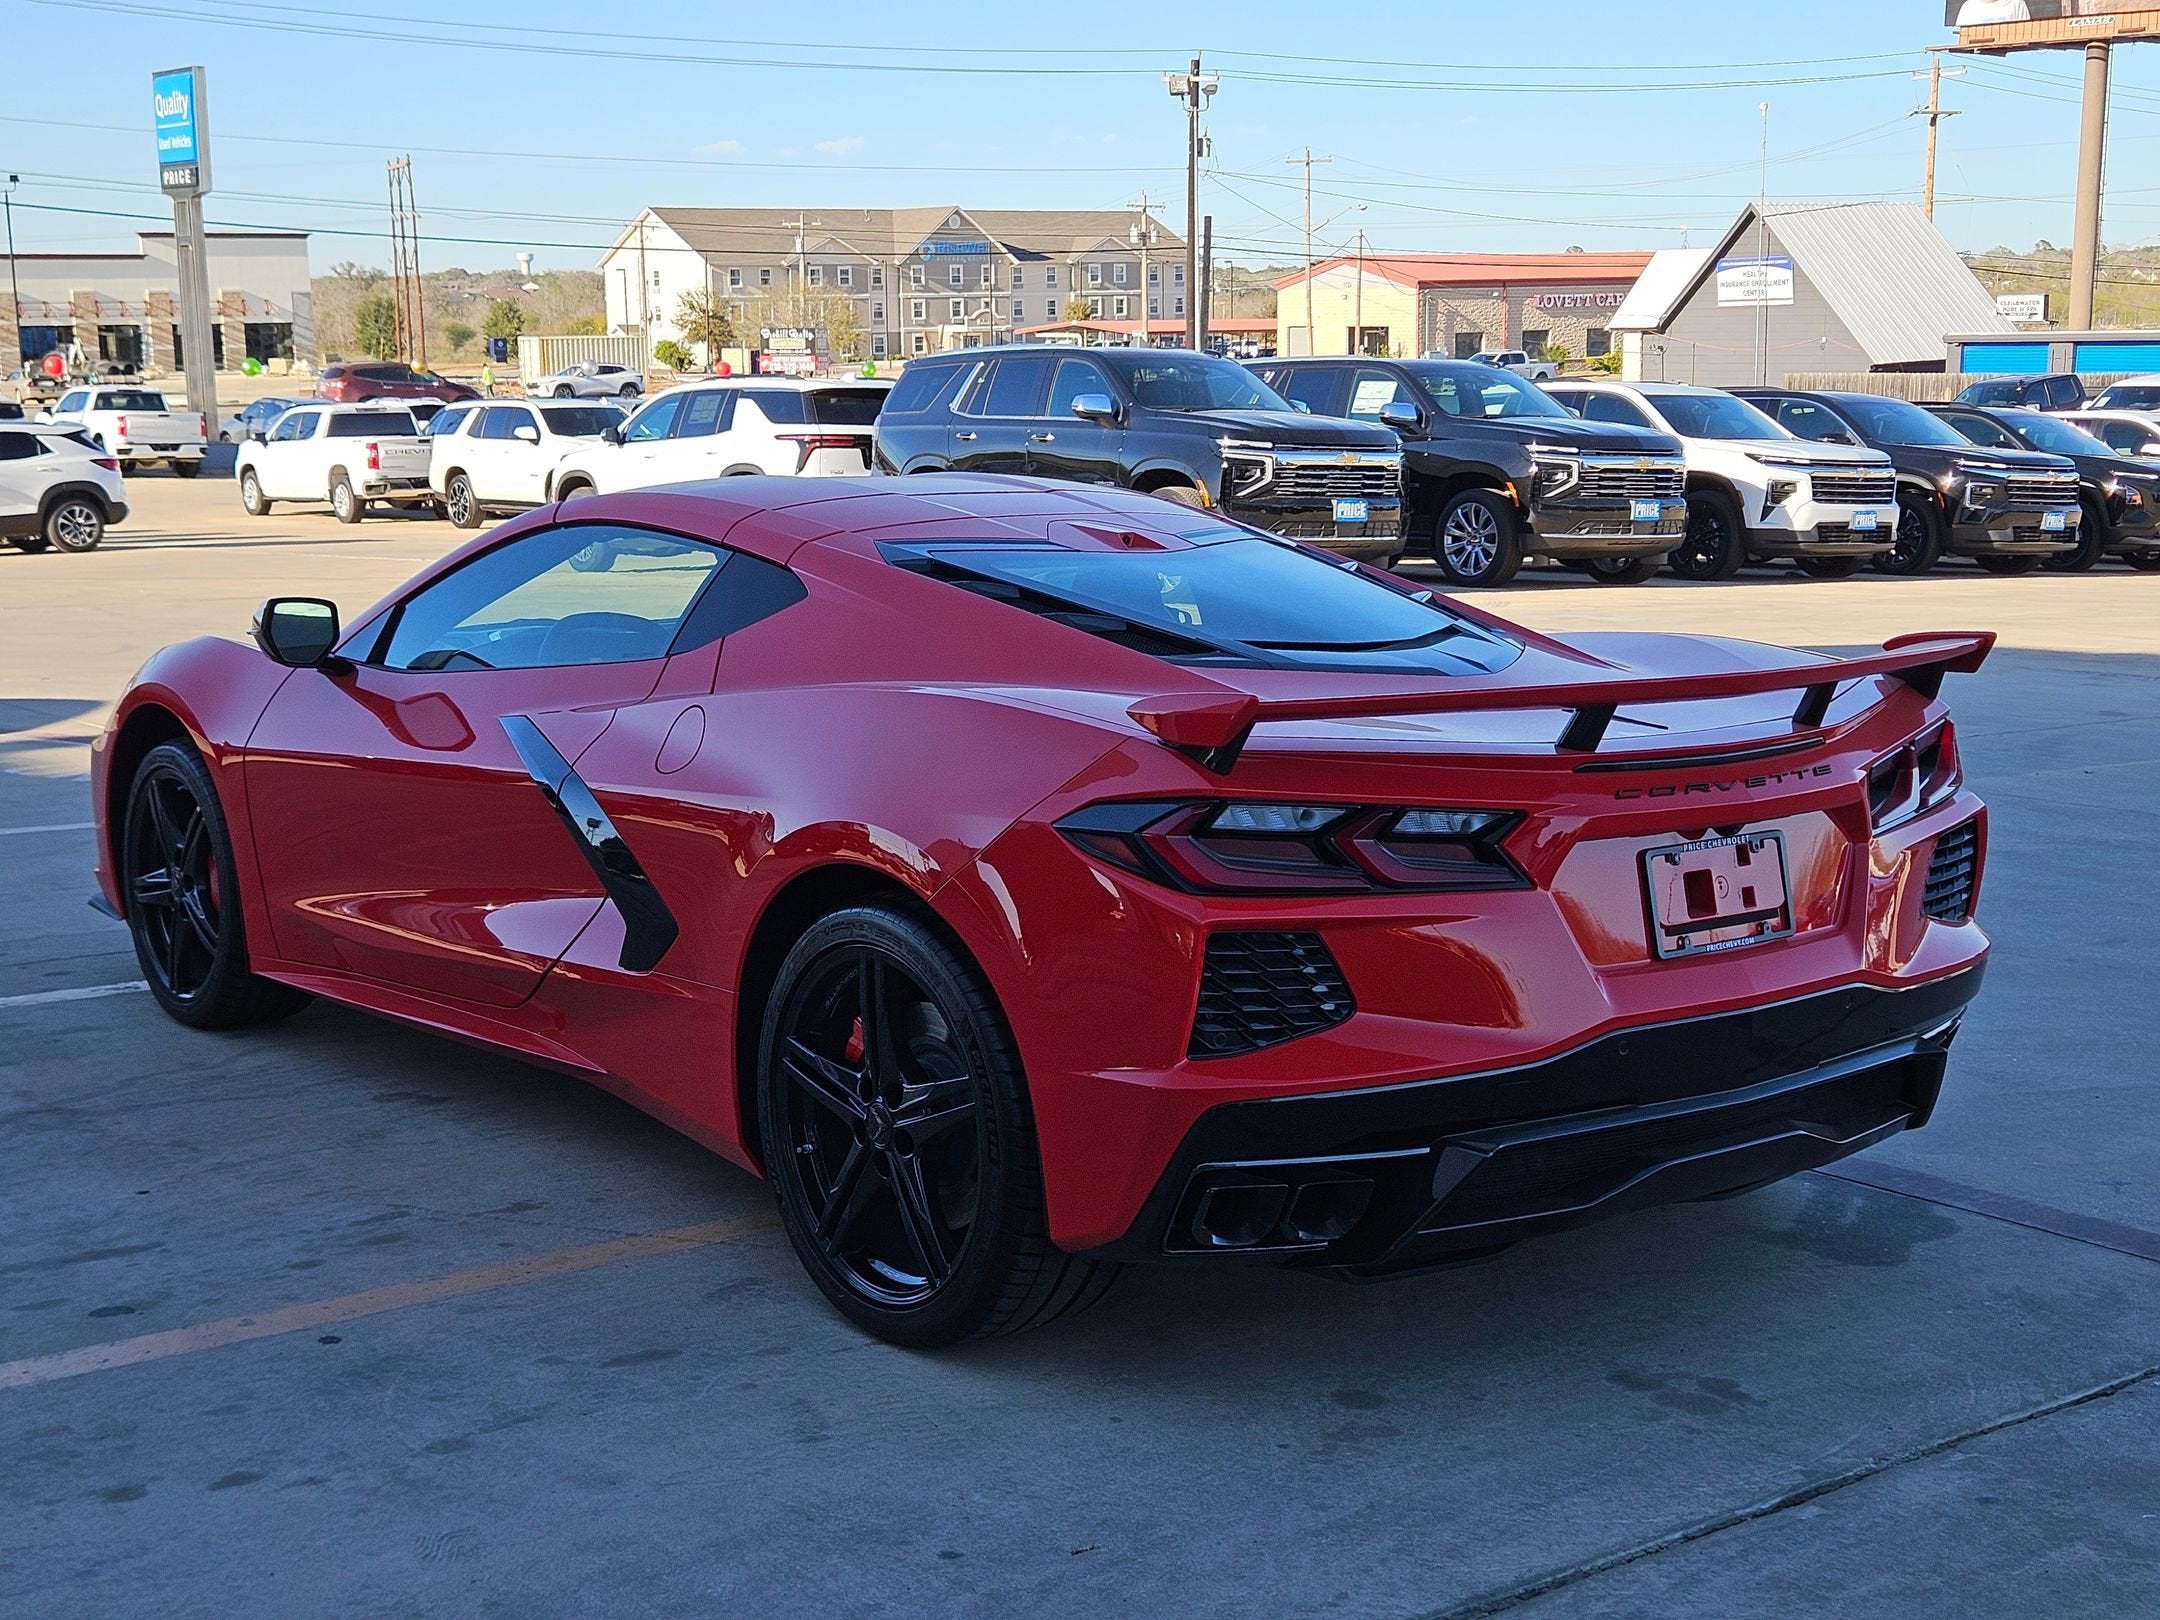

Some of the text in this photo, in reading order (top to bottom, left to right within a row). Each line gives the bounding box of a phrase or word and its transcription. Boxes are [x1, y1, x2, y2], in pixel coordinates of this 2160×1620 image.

[2070, 16, 2114, 26] LAMAR
[155, 91, 188, 119] Quality
[163, 169, 192, 185] PRICE
[1534, 293, 1593, 308] LOVETT
[1337, 502, 1367, 516] PRICE
[1635, 503, 1660, 516] PRICE
[1614, 764, 1832, 800] CORVETTE
[1683, 835, 1750, 852] PRICE CHEVROLET
